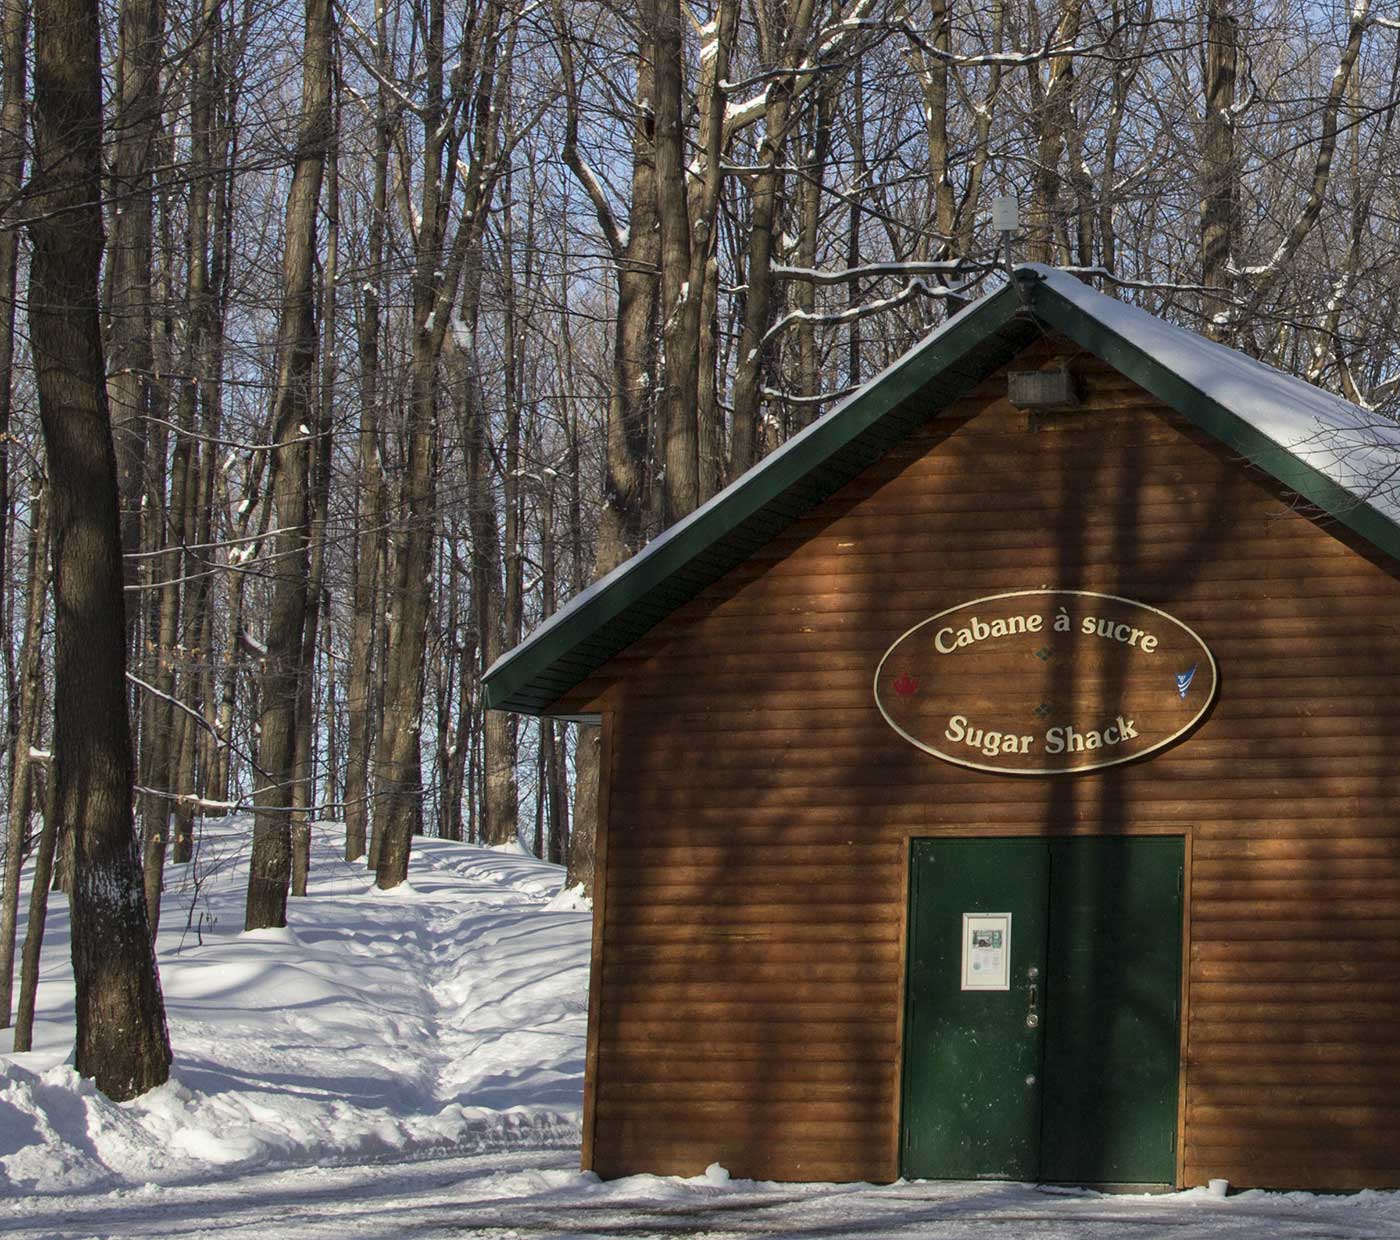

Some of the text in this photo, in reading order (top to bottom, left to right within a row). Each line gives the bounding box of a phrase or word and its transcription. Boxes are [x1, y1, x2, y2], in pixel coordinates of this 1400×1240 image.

[934, 607, 1159, 654] Cabane à sucre
[945, 714, 1139, 756] Sugar Shack
